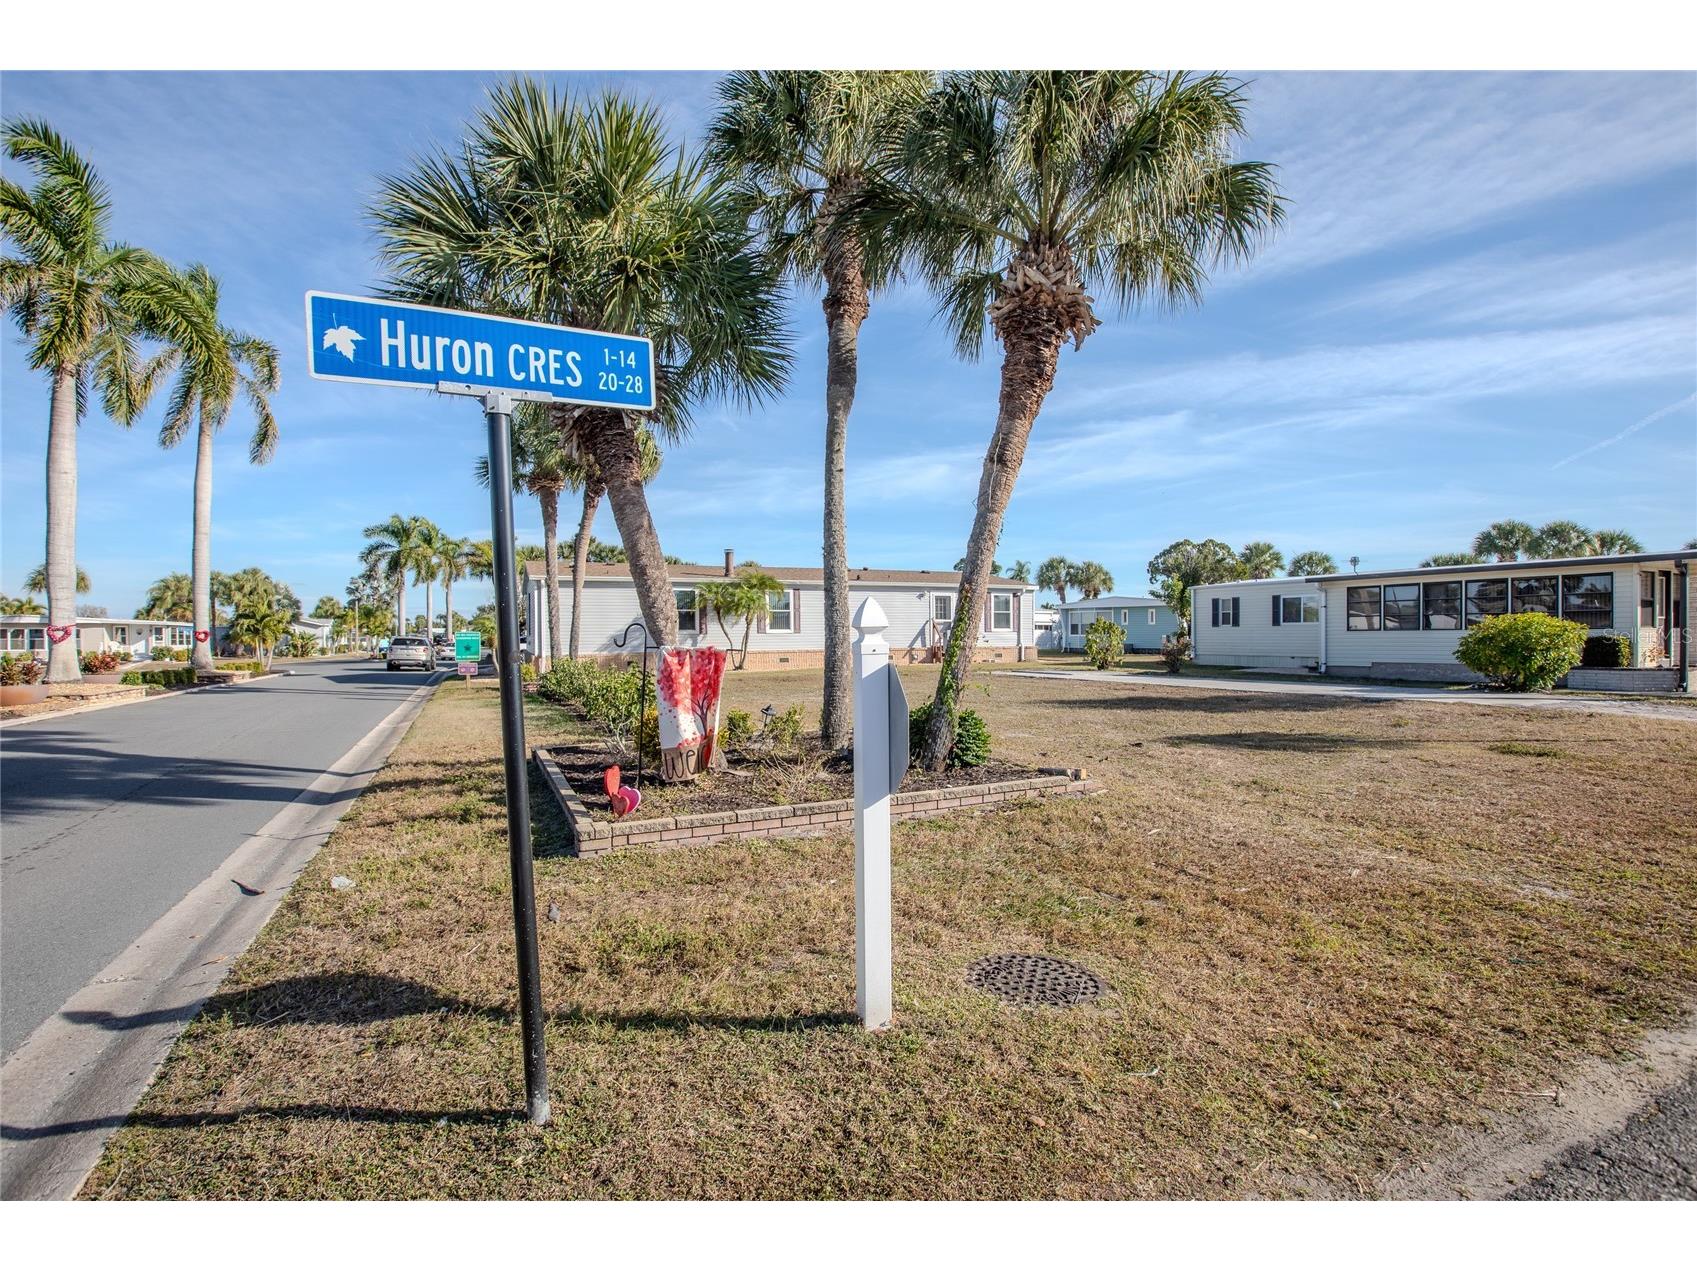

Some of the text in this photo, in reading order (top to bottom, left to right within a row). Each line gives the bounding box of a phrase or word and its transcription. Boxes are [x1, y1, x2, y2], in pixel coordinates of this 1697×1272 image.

[380, 318, 583, 388] Huron CRES
[603, 347, 636, 369] 1-14
[598, 371, 643, 394] 20-28
